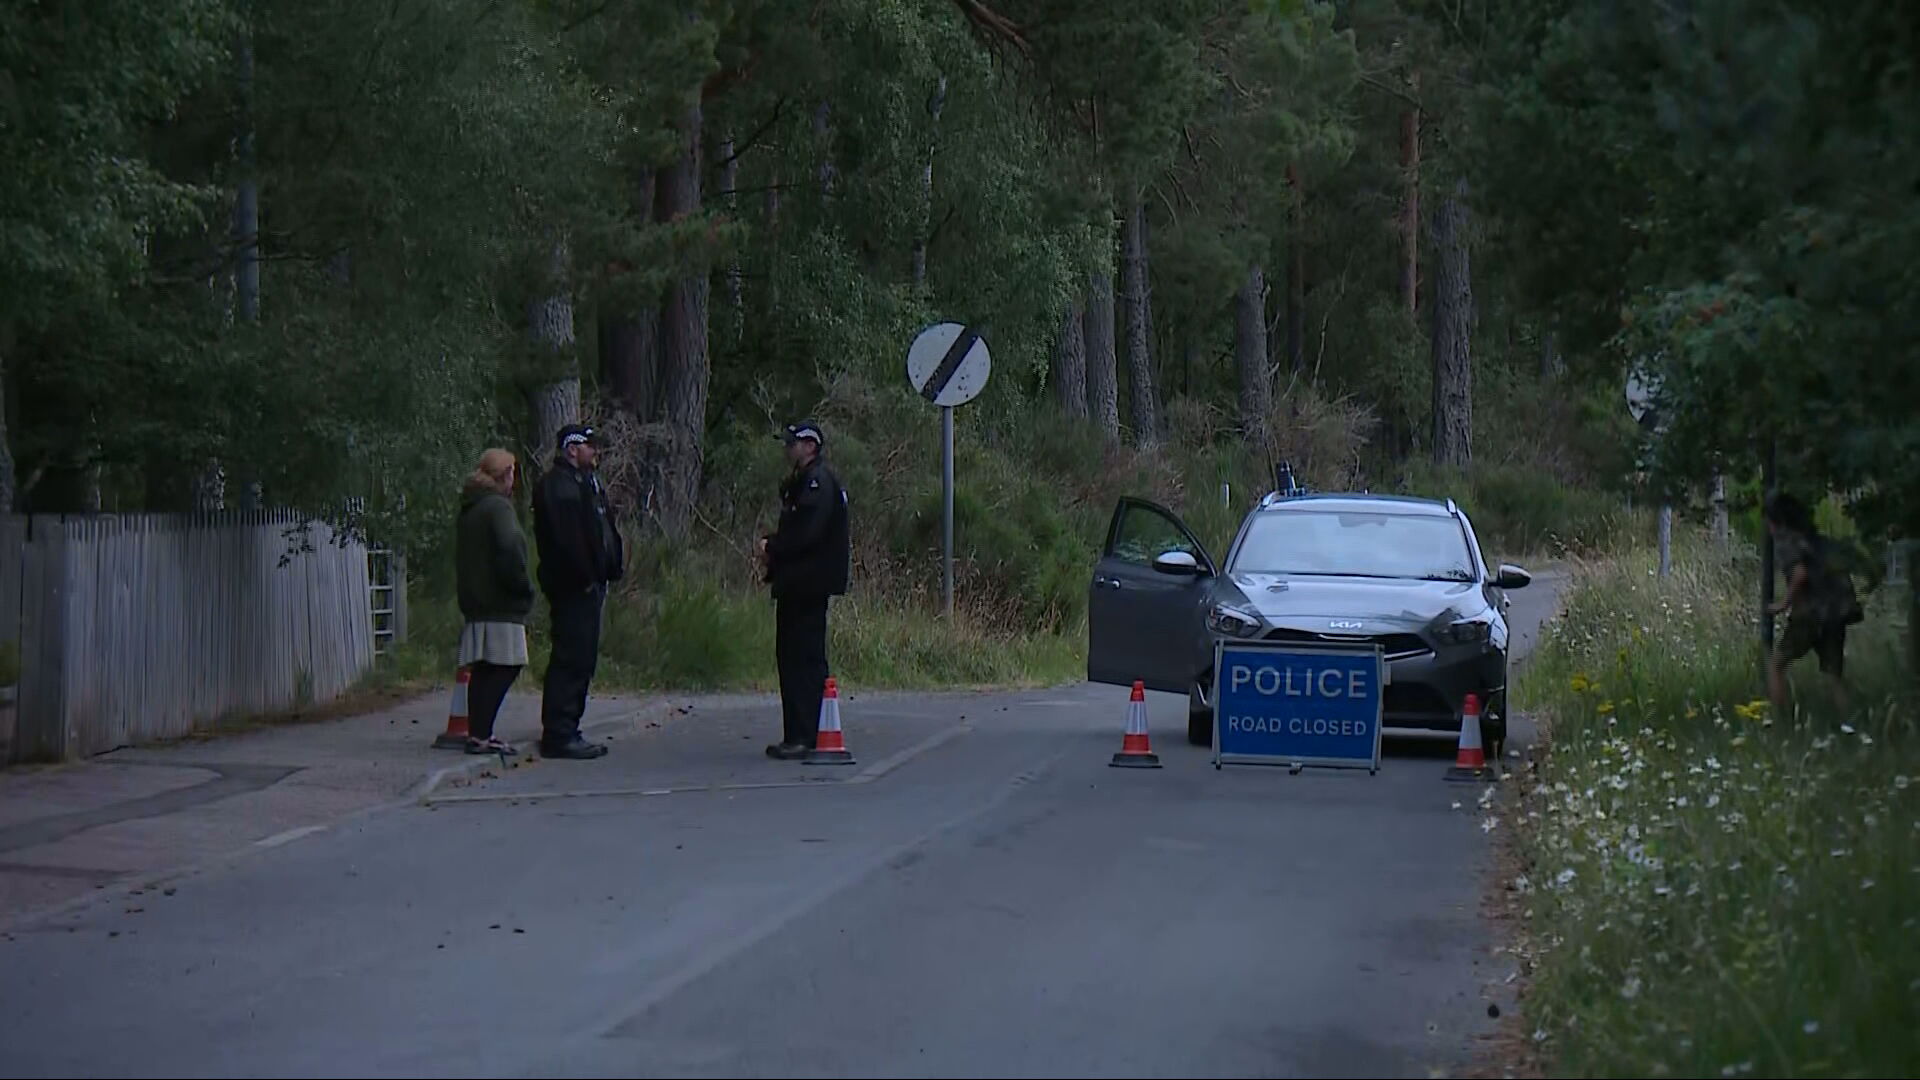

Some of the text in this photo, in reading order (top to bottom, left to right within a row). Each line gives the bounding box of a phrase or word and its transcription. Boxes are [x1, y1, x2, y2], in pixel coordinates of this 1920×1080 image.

[1231, 666, 1367, 698] POLICE
[1229, 716, 1367, 736] ROAD CLOSED
